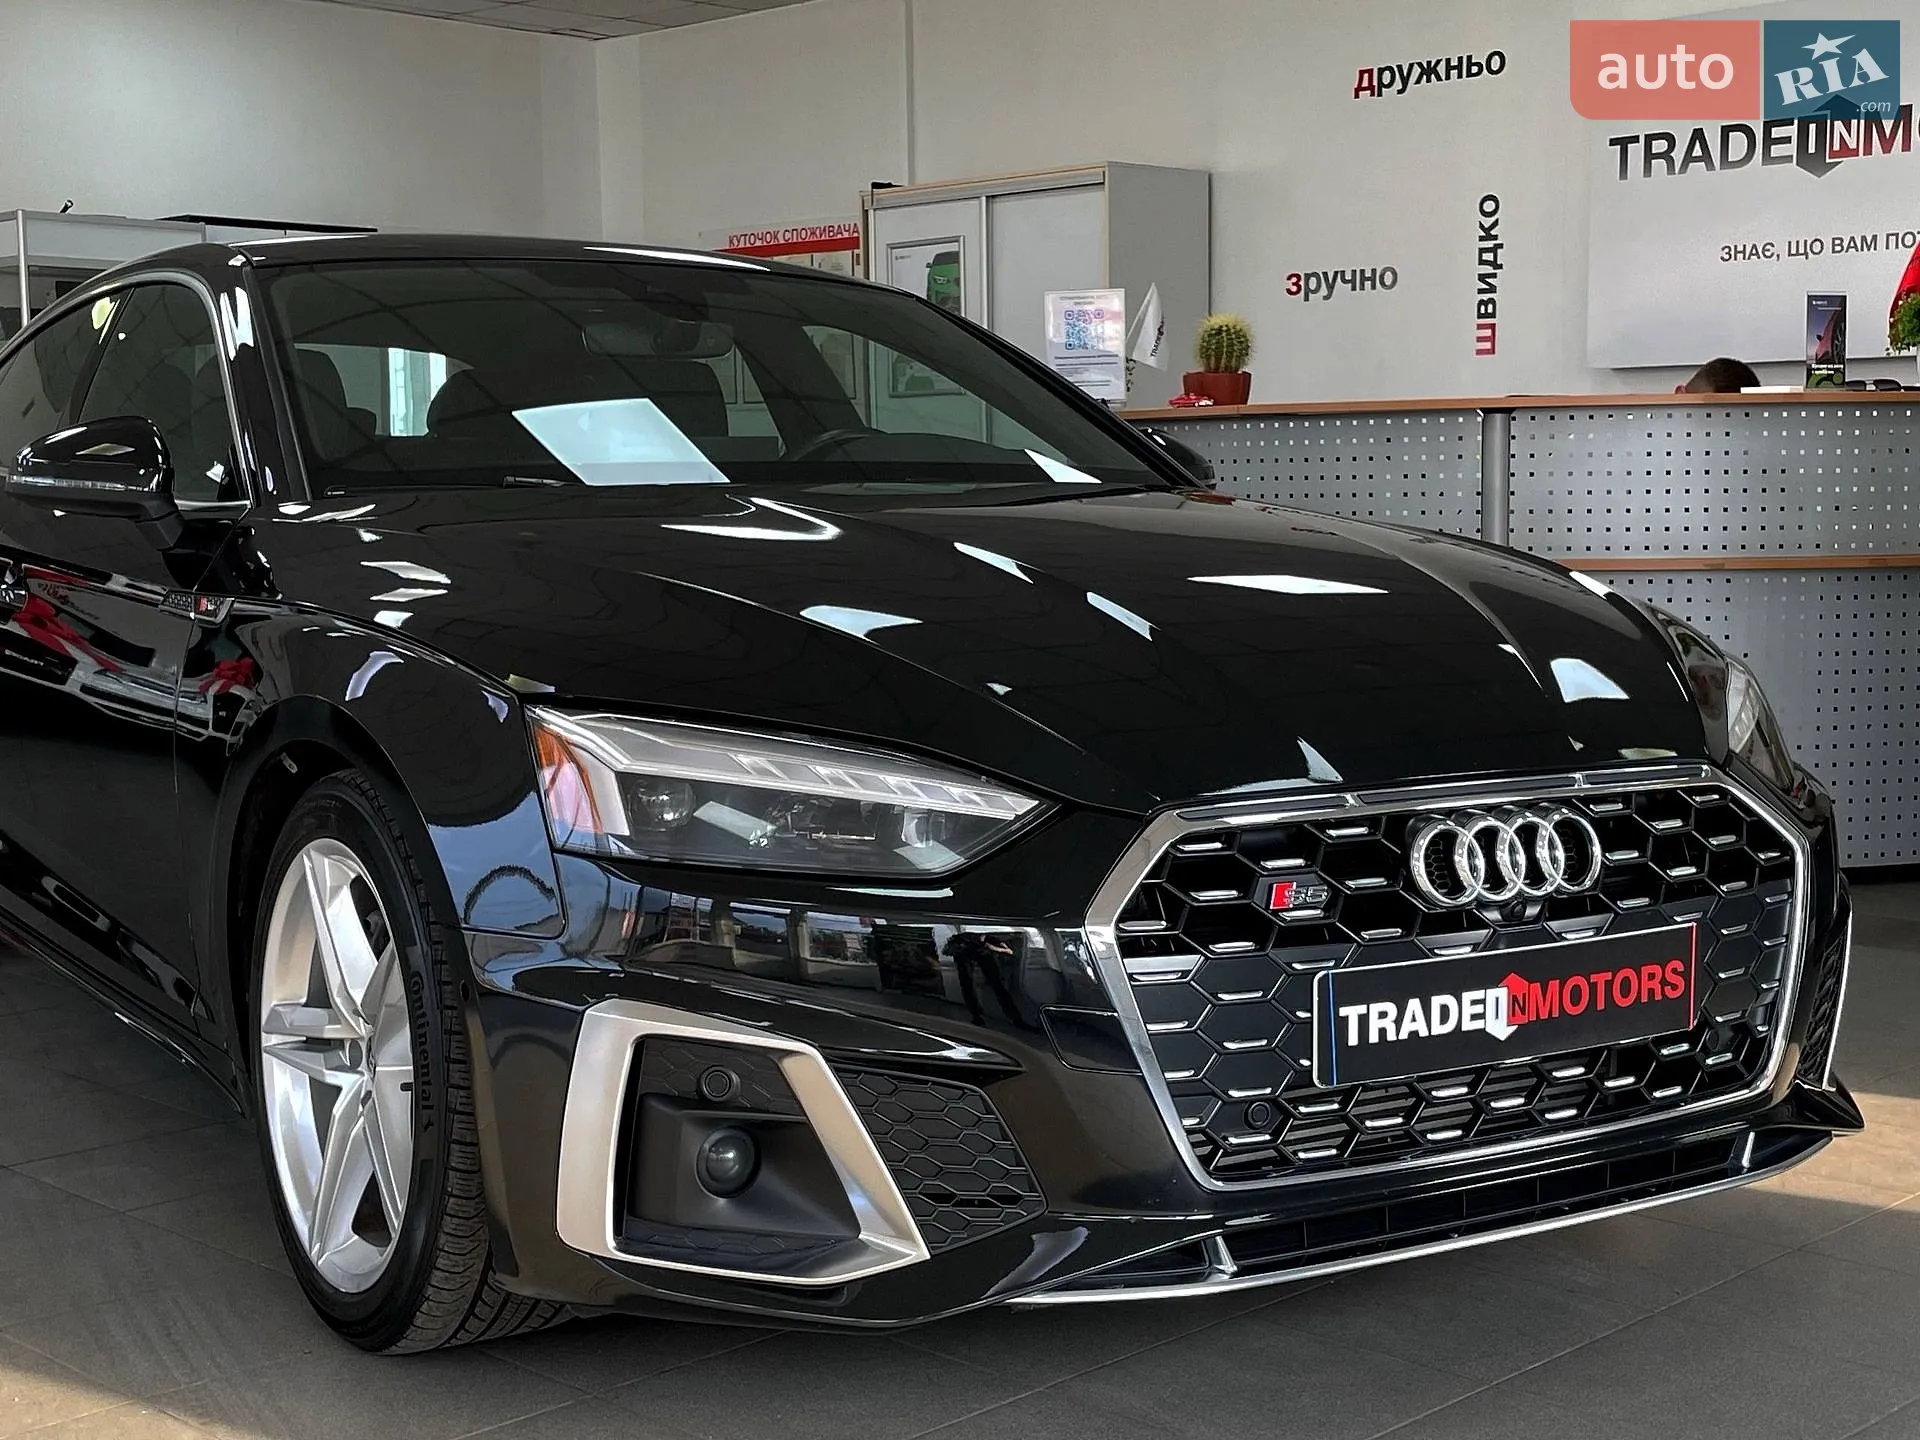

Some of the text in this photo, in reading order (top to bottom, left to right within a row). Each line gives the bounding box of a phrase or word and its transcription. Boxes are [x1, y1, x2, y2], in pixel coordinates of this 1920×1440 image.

[1353, 50, 1507, 99] дружньо
[1608, 103, 1920, 181] TRADEINM
[728, 222, 860, 248] КУТОЧОК СПОЖИВАЧА
[1719, 230, 1920, 262] ЗНАЄ, ЩО ВАМ ПО
[1286, 266, 1399, 302] зручно
[408, 970, 435, 1112] Continental
